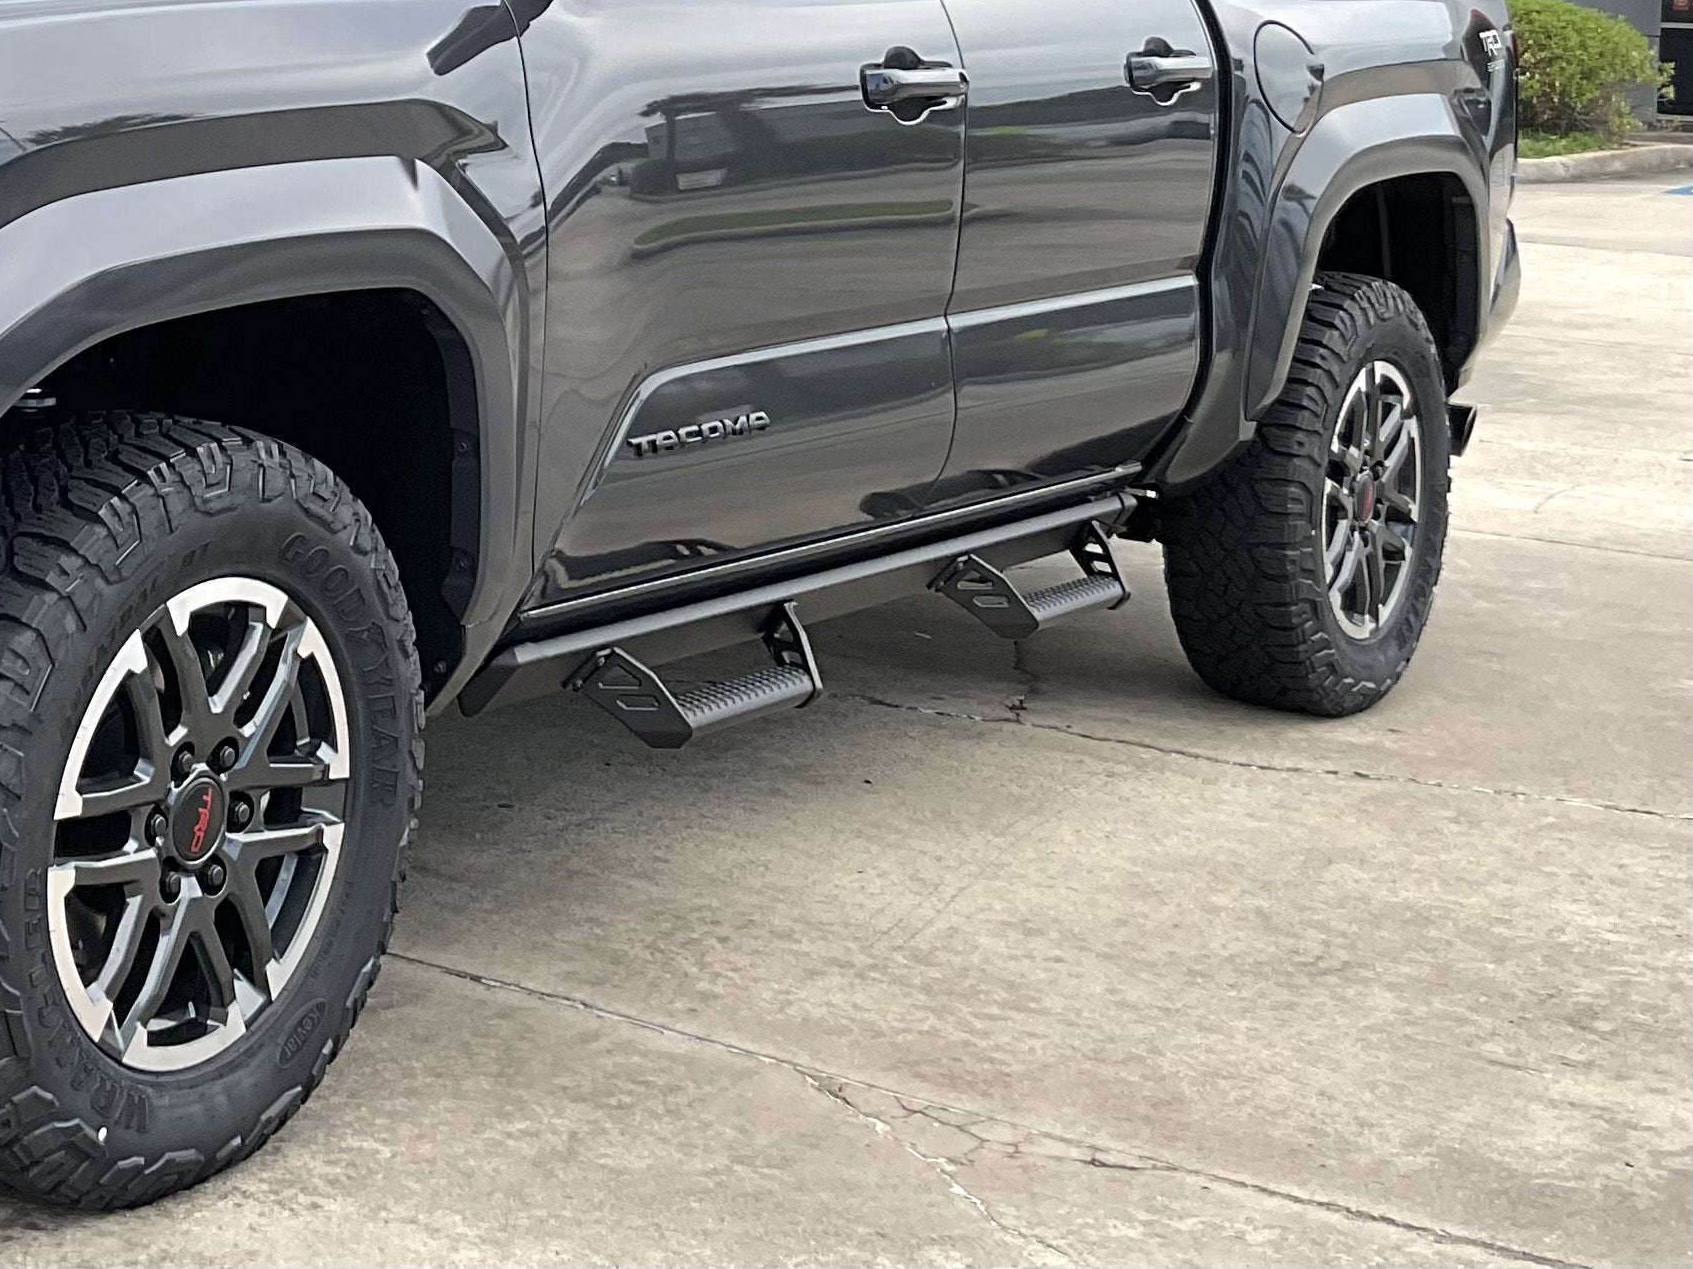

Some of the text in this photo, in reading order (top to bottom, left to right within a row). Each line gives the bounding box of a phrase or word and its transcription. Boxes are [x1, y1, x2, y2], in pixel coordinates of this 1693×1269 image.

[1479, 30, 1501, 56] TRD
[627, 410, 771, 457] TACOMA
[281, 532, 402, 811] GOODYEAR
[190, 786, 214, 852] TRD
[22, 867, 150, 1135] WRANGLER
[283, 1005, 327, 1060] Kevlar
